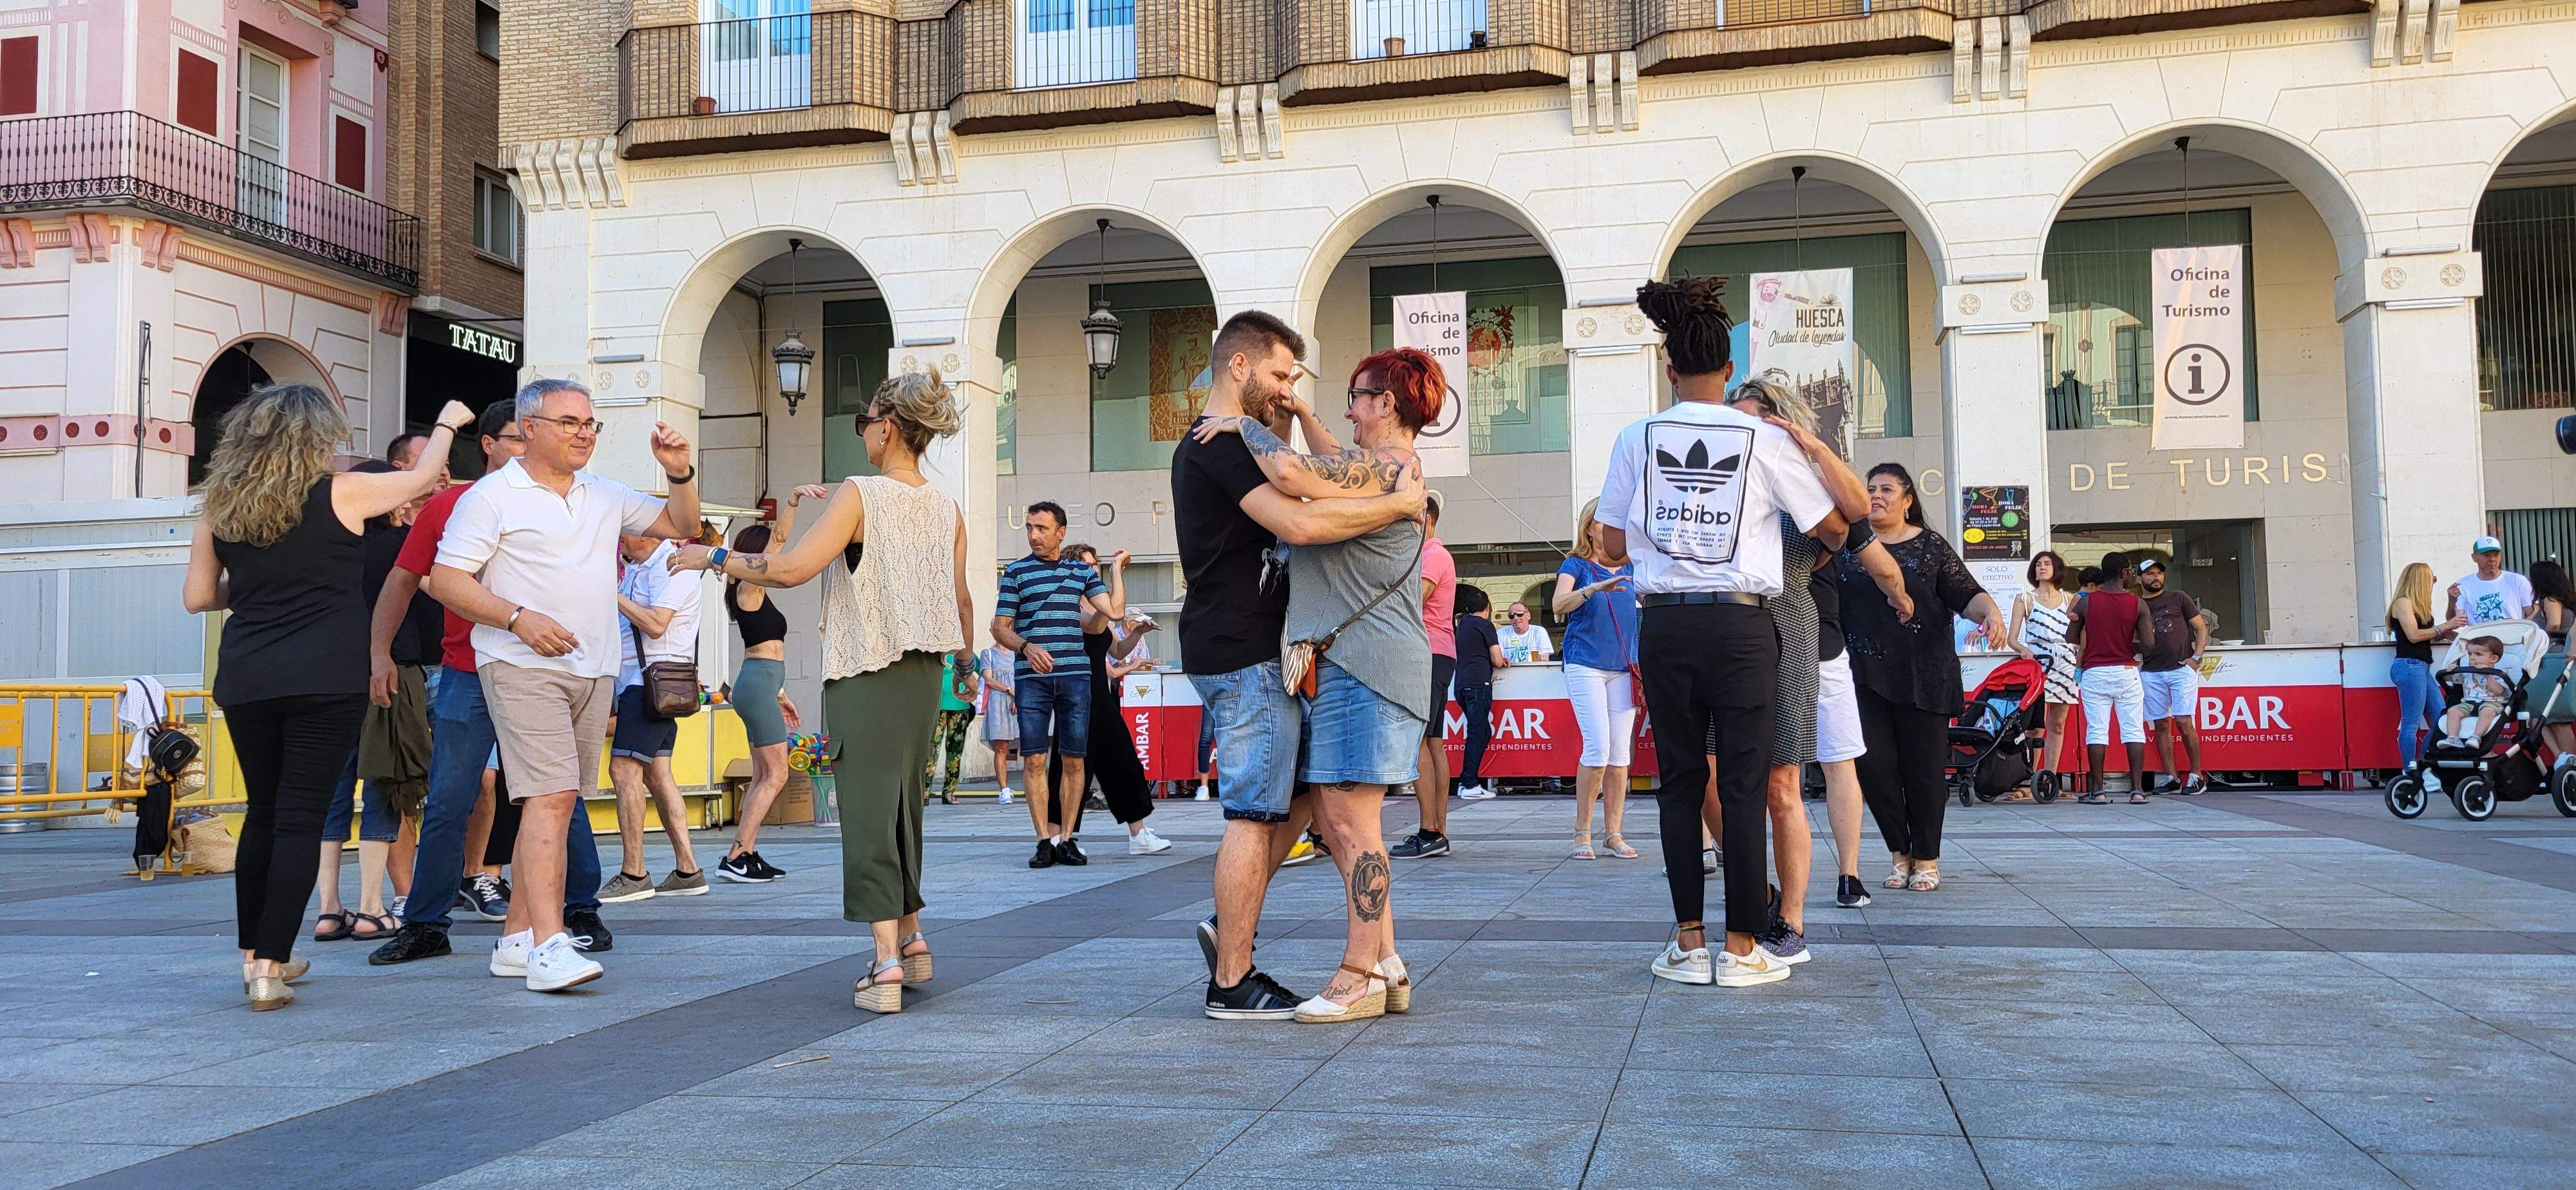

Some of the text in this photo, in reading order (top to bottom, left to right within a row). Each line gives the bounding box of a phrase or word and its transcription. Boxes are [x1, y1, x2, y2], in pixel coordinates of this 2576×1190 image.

[2170, 267, 2230, 281] Oficina
[2209, 285, 2230, 298] de
[1408, 311, 1460, 325] Oficina
[1795, 308, 1845, 328] HUESCA
[2162, 304, 2230, 317] Turismo
[1442, 327, 1460, 339] de
[1768, 330, 1846, 348] Ciudad de leyendas
[449, 323, 516, 363] TATAU
[2070, 453, 2348, 491] DE TURIS
[1007, 502, 1115, 530] UEO
[2192, 695, 2292, 730] BAR
[1442, 708, 1551, 740] MAR
[1135, 712, 1150, 771] AMBAR
[2201, 734, 2294, 742] INDEPENDIENTES
